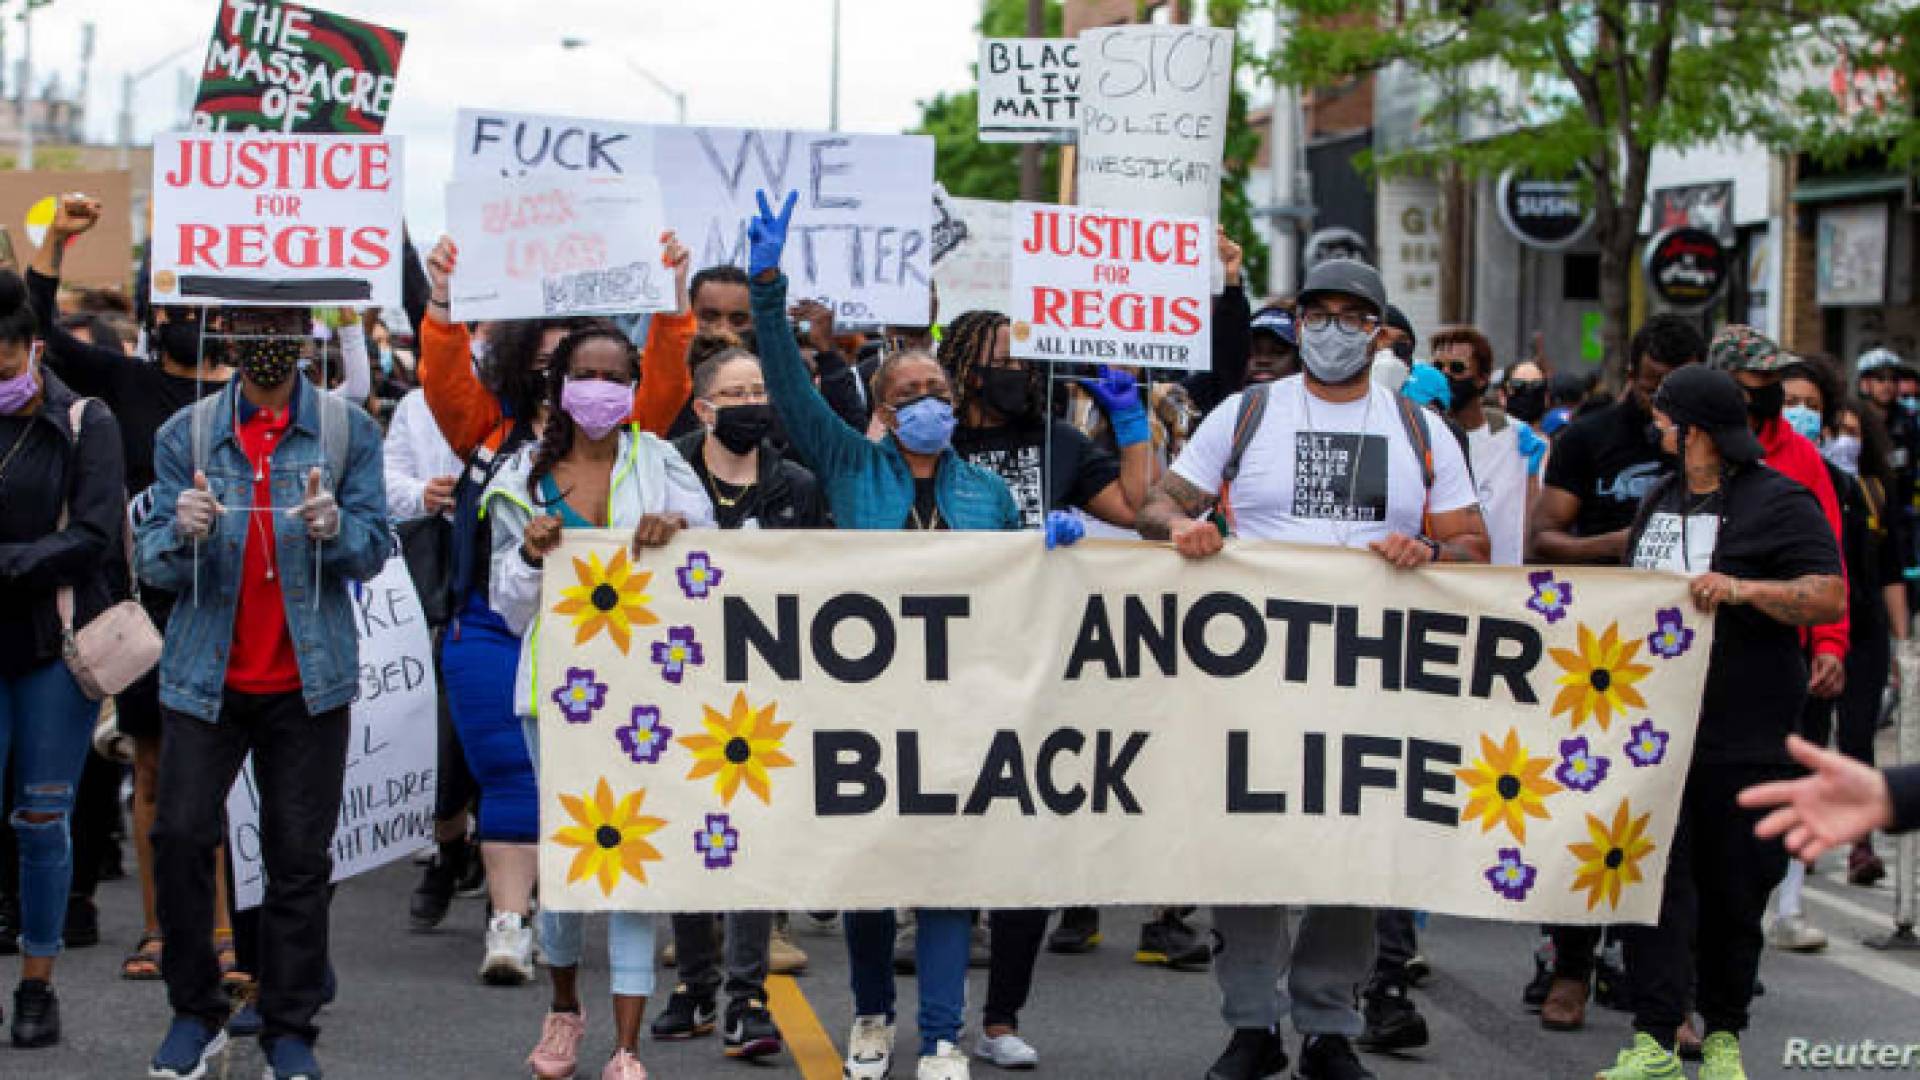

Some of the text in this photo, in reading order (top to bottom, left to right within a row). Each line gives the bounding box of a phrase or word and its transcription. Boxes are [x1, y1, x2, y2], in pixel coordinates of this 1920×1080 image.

[228, 0, 313, 52] THE
[207, 39, 394, 117] MASSACRE
[989, 42, 1080, 74] BLAC
[1017, 71, 1080, 94] LIV
[262, 87, 314, 134] OF
[993, 95, 1080, 121] MATT
[1082, 105, 1213, 141] POLICE
[165, 139, 391, 191] JUSTICE
[472, 117, 631, 174] FUCK
[694, 129, 861, 209] WE
[255, 193, 301, 217] FOR
[177, 222, 392, 272] REGIS
[705, 215, 929, 289] MTTER
[1023, 210, 1200, 266] JUSTICE
[1093, 264, 1131, 284] FOR
[1032, 286, 1202, 336] REGIS
[1034, 337, 1189, 362] ALL LIVES MATTER
[1298, 437, 1331, 449] GET
[1299, 449, 1348, 462] YOUR
[1296, 475, 1332, 489] OFF
[1298, 461, 1346, 476] KNEE
[1296, 489, 1334, 502] OUR
[723, 590, 1543, 704] NOT ANOTHER
[812, 726, 1463, 828] BLACK LIFE
